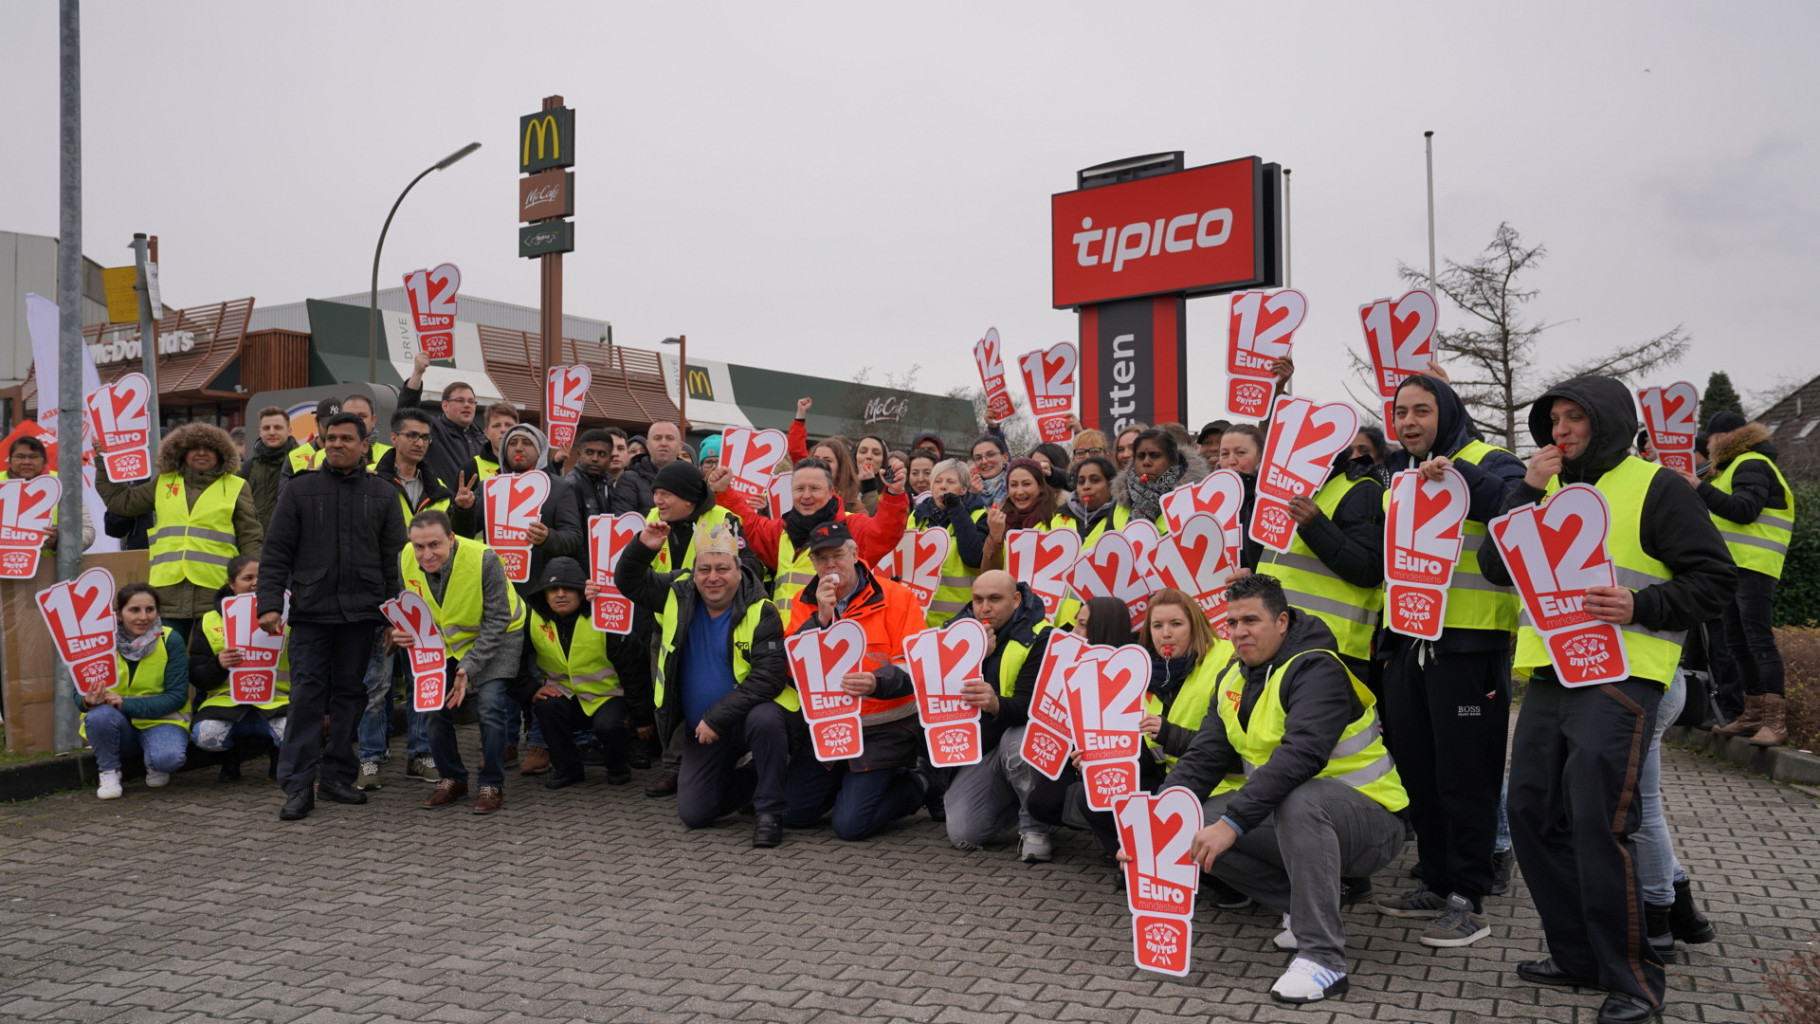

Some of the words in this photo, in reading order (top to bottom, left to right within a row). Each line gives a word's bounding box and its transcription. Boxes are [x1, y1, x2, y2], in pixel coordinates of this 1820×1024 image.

[1072, 208, 1233, 272] tipico
[407, 264, 459, 315] 12
[399, 317, 413, 360] DRIVE
[419, 315, 449, 326] Euro
[1233, 291, 1305, 358] 12
[1365, 291, 1436, 371] 12
[976, 328, 1003, 379] 12
[1023, 343, 1076, 395] 12
[1235, 350, 1274, 370] Euro
[90, 375, 147, 432] 12
[550, 366, 589, 411] 12
[553, 406, 576, 418] Euro
[1036, 397, 1067, 409] Euro
[1642, 382, 1697, 434] 12
[104, 432, 141, 446] Euro
[726, 429, 784, 488] 12
[1272, 400, 1355, 485] 12
[1655, 432, 1688, 444] Euro
[0, 476, 58, 531] 12
[488, 472, 548, 529] 12
[1266, 465, 1305, 494] Euro
[1, 527, 38, 541] Euro
[494, 526, 527, 540] Euro
[1167, 473, 1240, 547] 12
[1393, 471, 1466, 560] 12
[896, 529, 948, 590] 12
[1011, 529, 1078, 596] 12
[1154, 516, 1232, 596] 12
[1394, 549, 1442, 574] Euro
[1501, 488, 1614, 593] 12
[597, 571, 616, 586] Eu
[1073, 534, 1150, 601] 12
[44, 570, 114, 638] 12
[388, 592, 444, 648] 12
[1399, 607, 1430, 620] UNITED
[1537, 595, 1586, 618] Eur
[67, 635, 108, 654] Euro
[415, 650, 441, 664] Euro
[792, 623, 863, 692] 12
[910, 622, 983, 695] 12
[1570, 650, 1610, 667] UNITED
[811, 694, 853, 710] Euro
[1067, 648, 1148, 731] 12
[1458, 705, 1481, 713] BOSS
[1084, 732, 1131, 750] Euro
[1098, 784, 1127, 795] UNITED
[1119, 791, 1199, 888] 12
[1138, 876, 1185, 904] Euro
[1139, 900, 1186, 914] mindestens
[1145, 940, 1178, 955] UNITED
